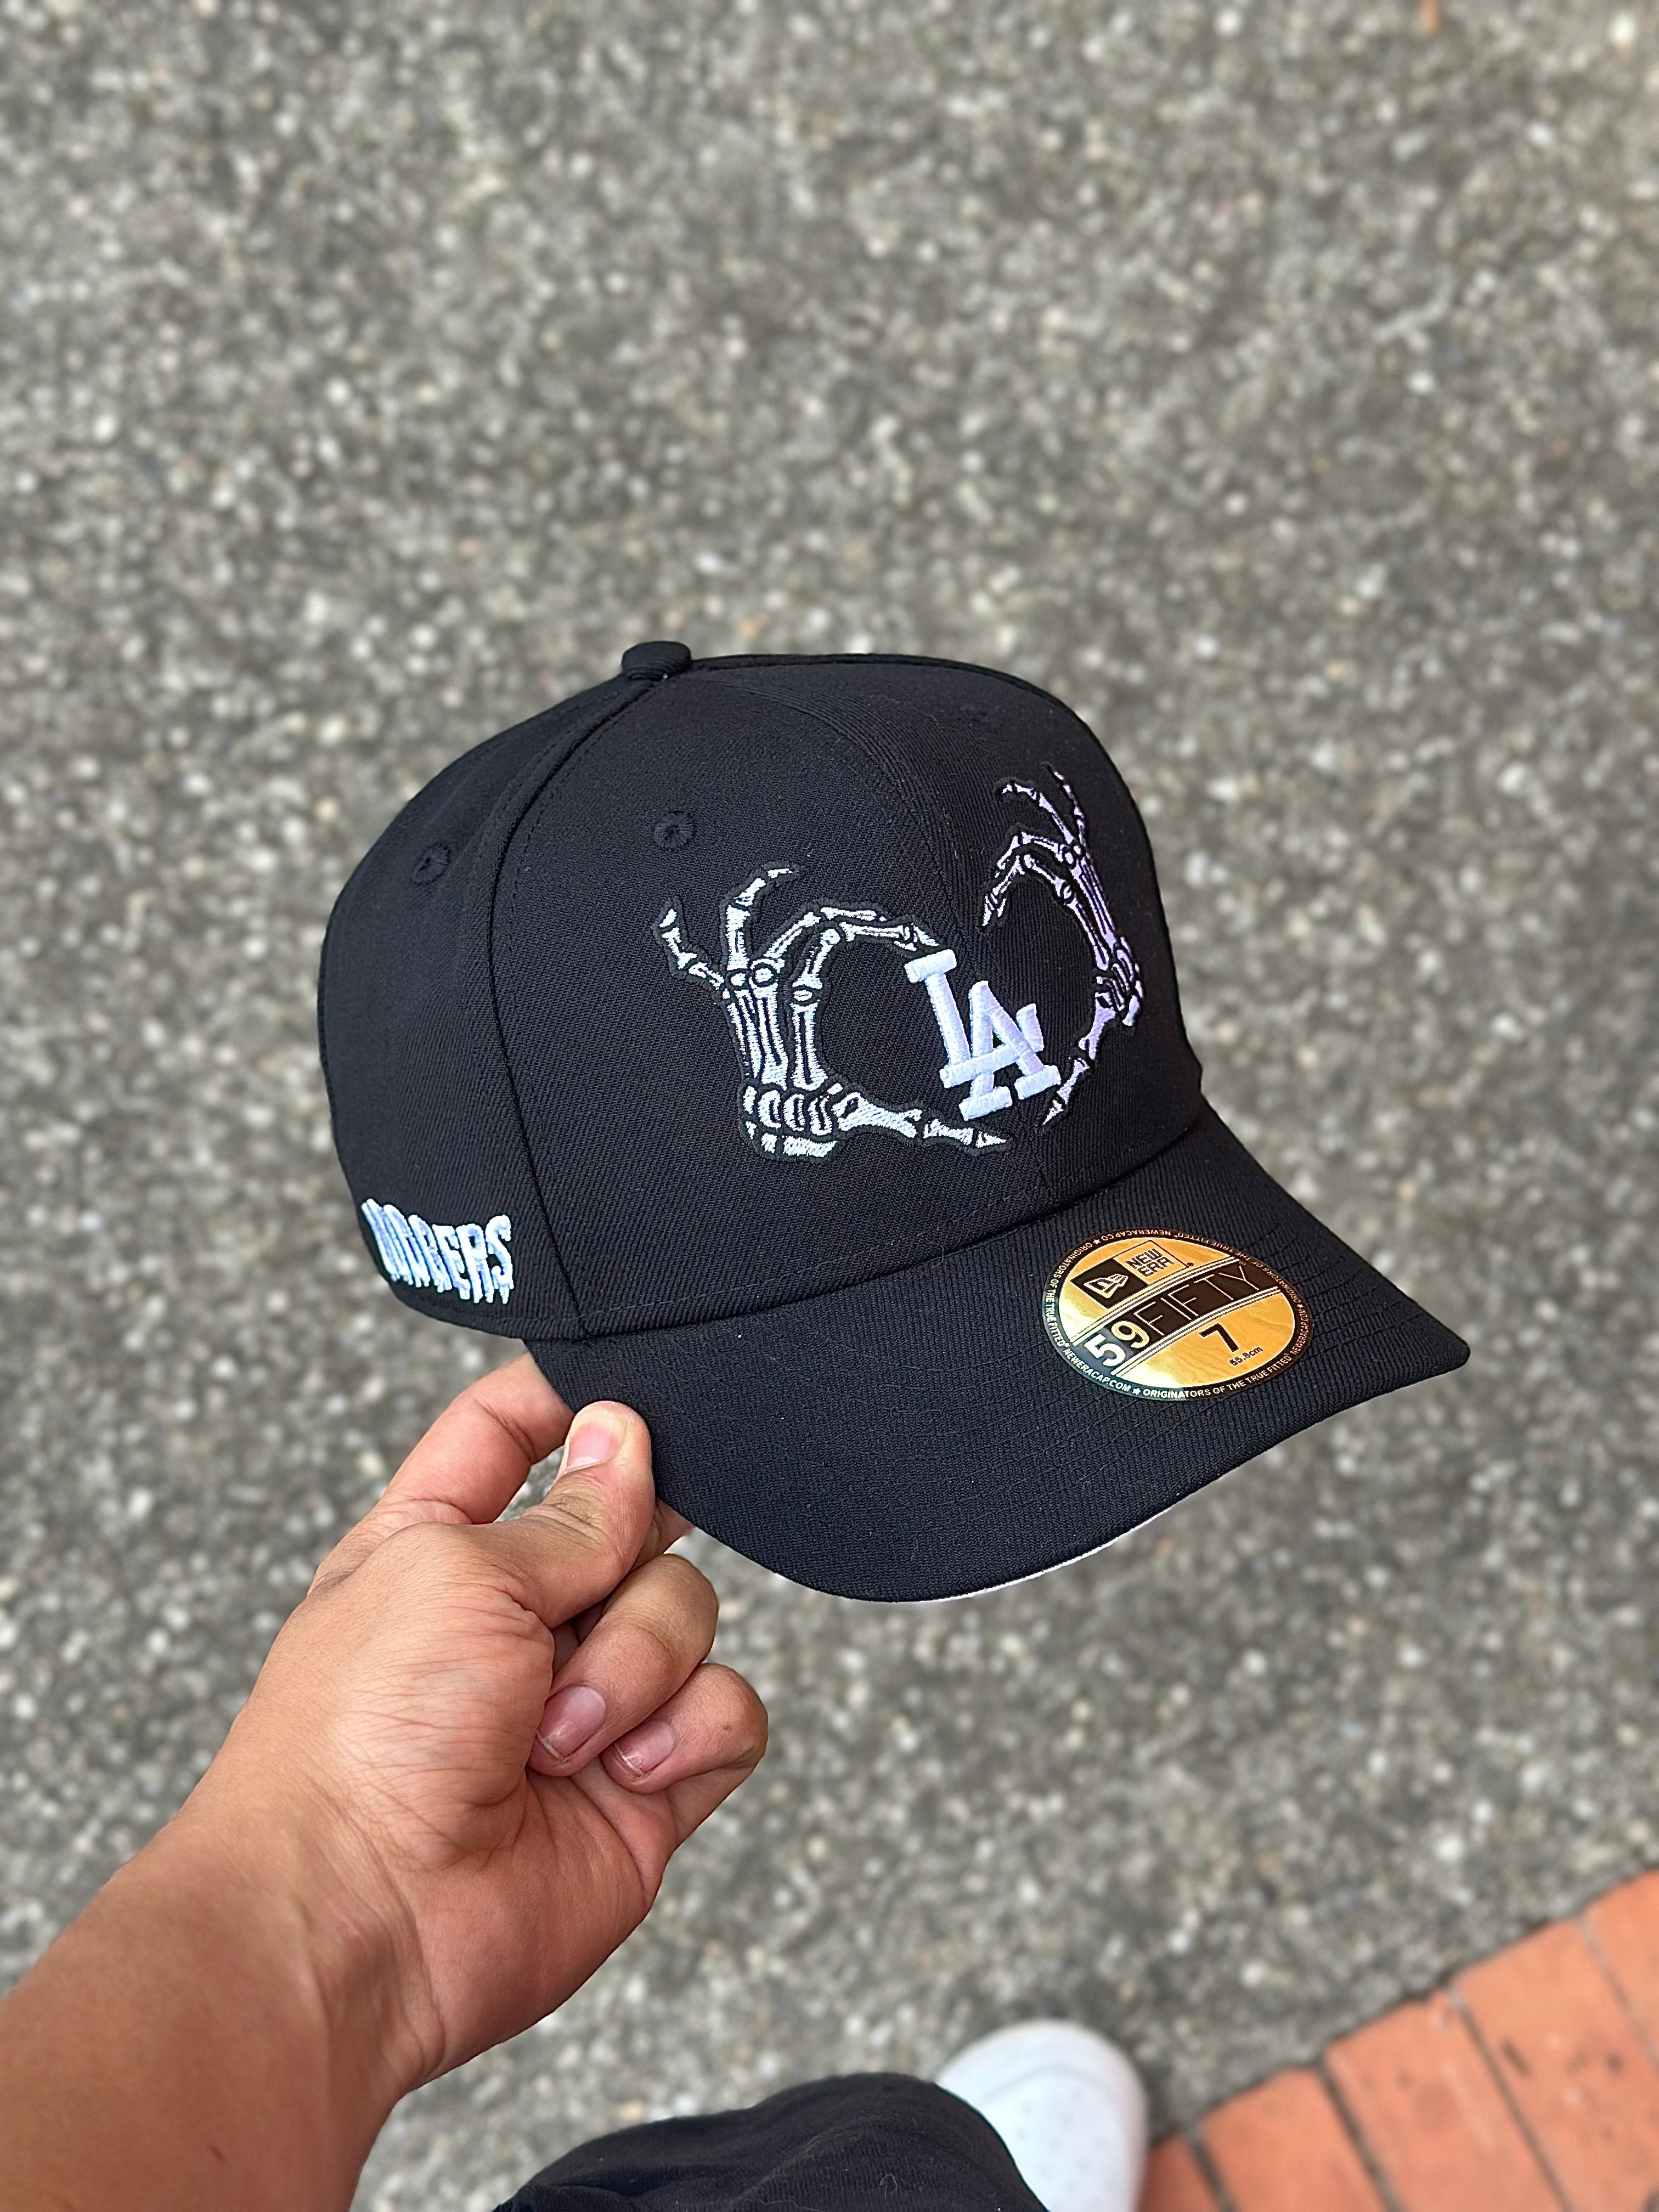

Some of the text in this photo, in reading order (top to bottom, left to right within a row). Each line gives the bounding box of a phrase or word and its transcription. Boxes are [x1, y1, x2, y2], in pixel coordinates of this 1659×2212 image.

[904, 949, 1062, 1121] LA
[1053, 1242, 1093, 1278] ORIGINATORS
[1125, 1248, 1163, 1269] NEW
[1137, 1256, 1174, 1277] ERA
[1049, 1279, 1059, 1288] OF
[1045, 1290, 1056, 1303] THE
[1045, 1305, 1057, 1322] TRUE
[1199, 1323, 1239, 1352] 7
[1143, 1389, 1211, 1398] ORIGINATORS
[1213, 1386, 1225, 1394] OF
[1226, 1380, 1246, 1391] THE
[1245, 1370, 1269, 1384] TRUE
